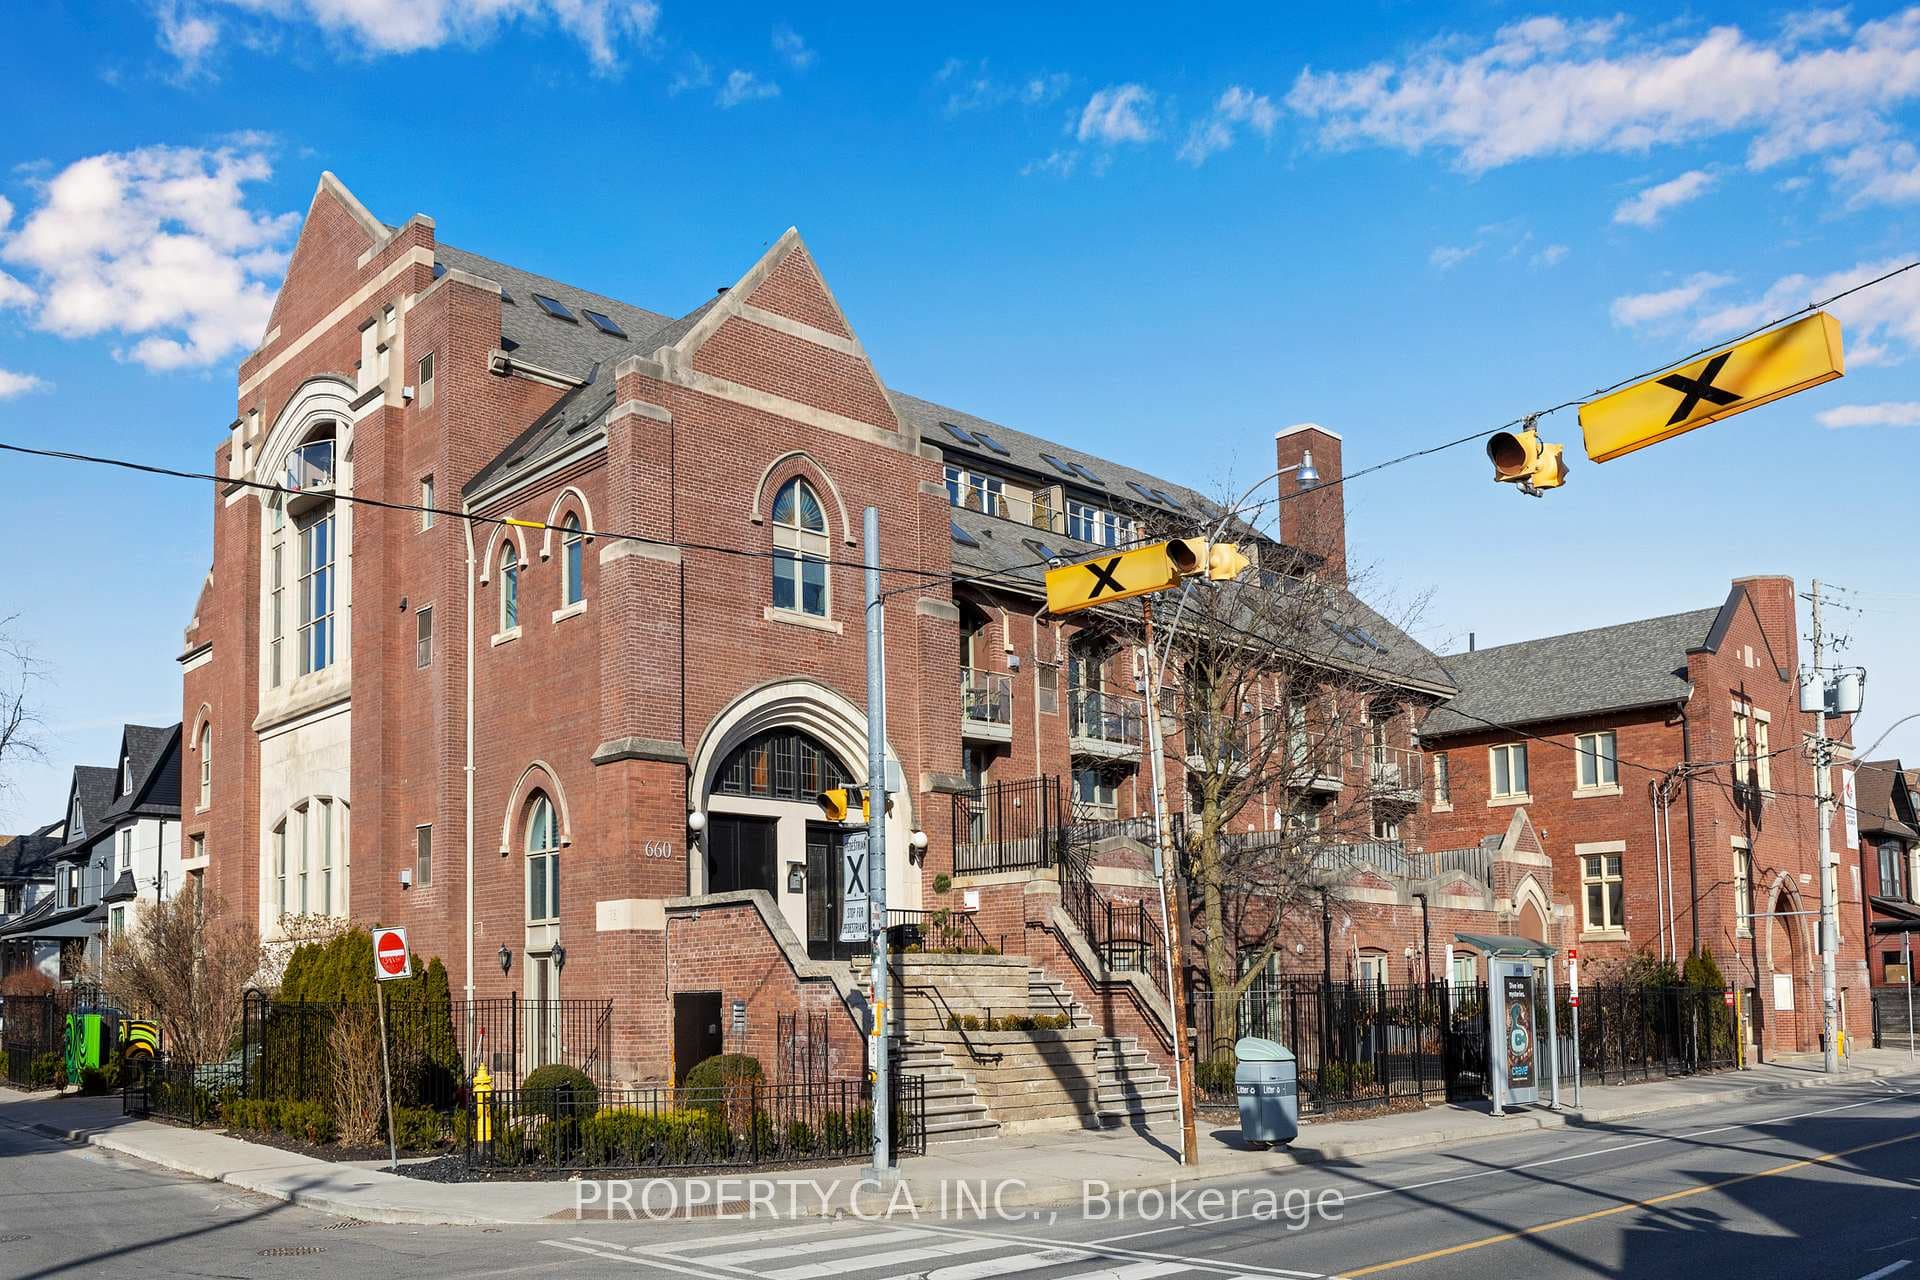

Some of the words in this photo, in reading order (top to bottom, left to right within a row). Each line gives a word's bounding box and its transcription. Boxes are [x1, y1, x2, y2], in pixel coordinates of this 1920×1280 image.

[1656, 350, 1744, 427] X
[1085, 556, 1126, 599] X
[645, 840, 672, 858] 660
[847, 854, 864, 894] X
[847, 907, 856, 919] STOP
[842, 922, 867, 934] PEDESTRIANS
[1236, 1085, 1249, 1094] Litter
[1263, 1085, 1275, 1094] Litter
